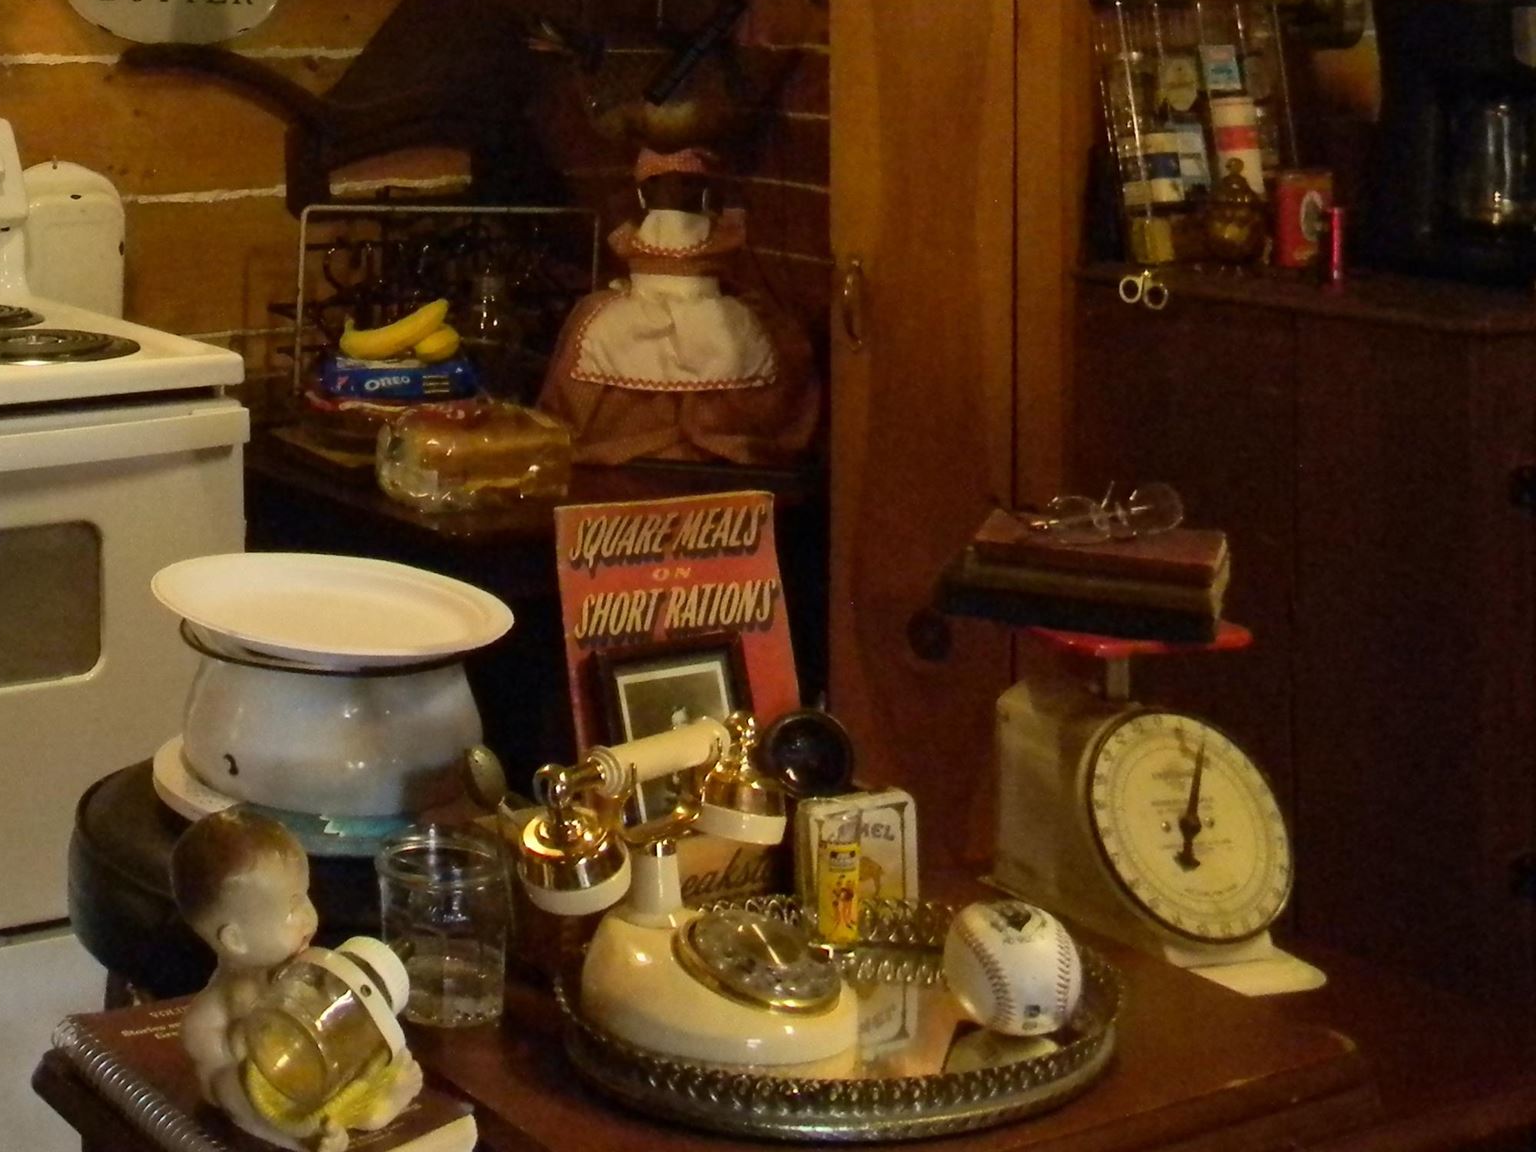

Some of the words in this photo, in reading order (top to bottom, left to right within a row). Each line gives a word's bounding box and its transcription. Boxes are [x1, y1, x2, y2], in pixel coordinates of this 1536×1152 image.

[364, 374, 412, 392] OREO
[569, 511, 679, 569] SQUARE
[672, 503, 767, 552] MEALS
[652, 566, 692, 582] ON
[574, 588, 663, 640] SHORT
[664, 577, 778, 629] RATIONS
